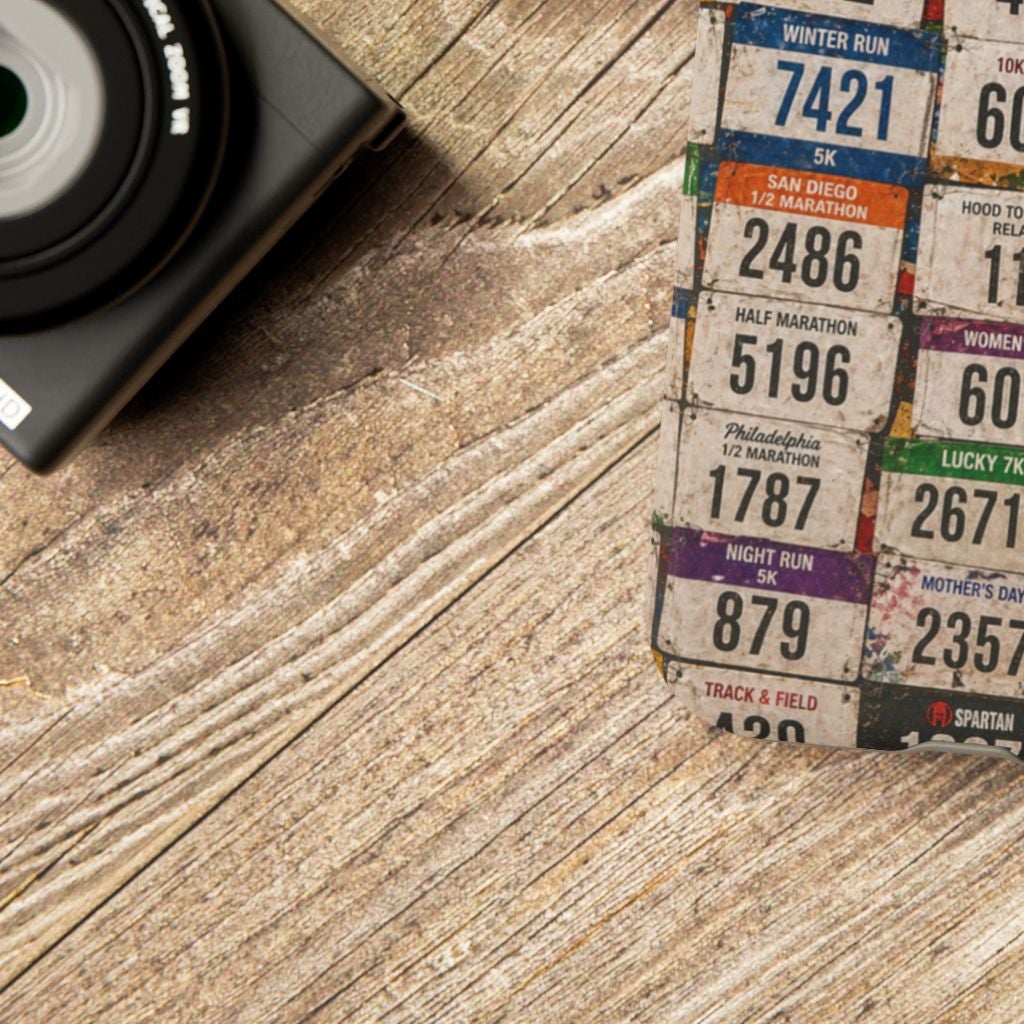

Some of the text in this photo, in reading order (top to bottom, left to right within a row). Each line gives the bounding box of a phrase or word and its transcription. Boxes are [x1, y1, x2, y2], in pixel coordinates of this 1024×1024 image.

[783, 23, 890, 56] WINTER RUN
[997, 57, 1024, 75] 10K
[774, 60, 894, 141] 7421
[813, 147, 837, 166] 5K
[767, 174, 858, 201] SAN DIEGO
[751, 191, 868, 220] 1/2 MARATHON
[961, 201, 1001, 217] HOOD
[1006, 205, 1024, 219] TO
[739, 217, 863, 293] 2486
[735, 307, 858, 336] HALF MARATHON
[729, 333, 851, 406] 5196
[724, 422, 822, 450] Philadelphia
[722, 443, 821, 468] 1/2 MARATHON
[941, 449, 1024, 475] LUCKY 7K
[709, 465, 821, 531] 1787
[911, 483, 1021, 549] 2671
[725, 543, 814, 572] NIGHT RUN
[756, 569, 779, 585] 5K
[921, 576, 994, 599] MOTHER'S
[712, 590, 811, 661] 879
[704, 681, 818, 711] TRACK & FIELD
[954, 708, 1015, 732] SPARTAN
